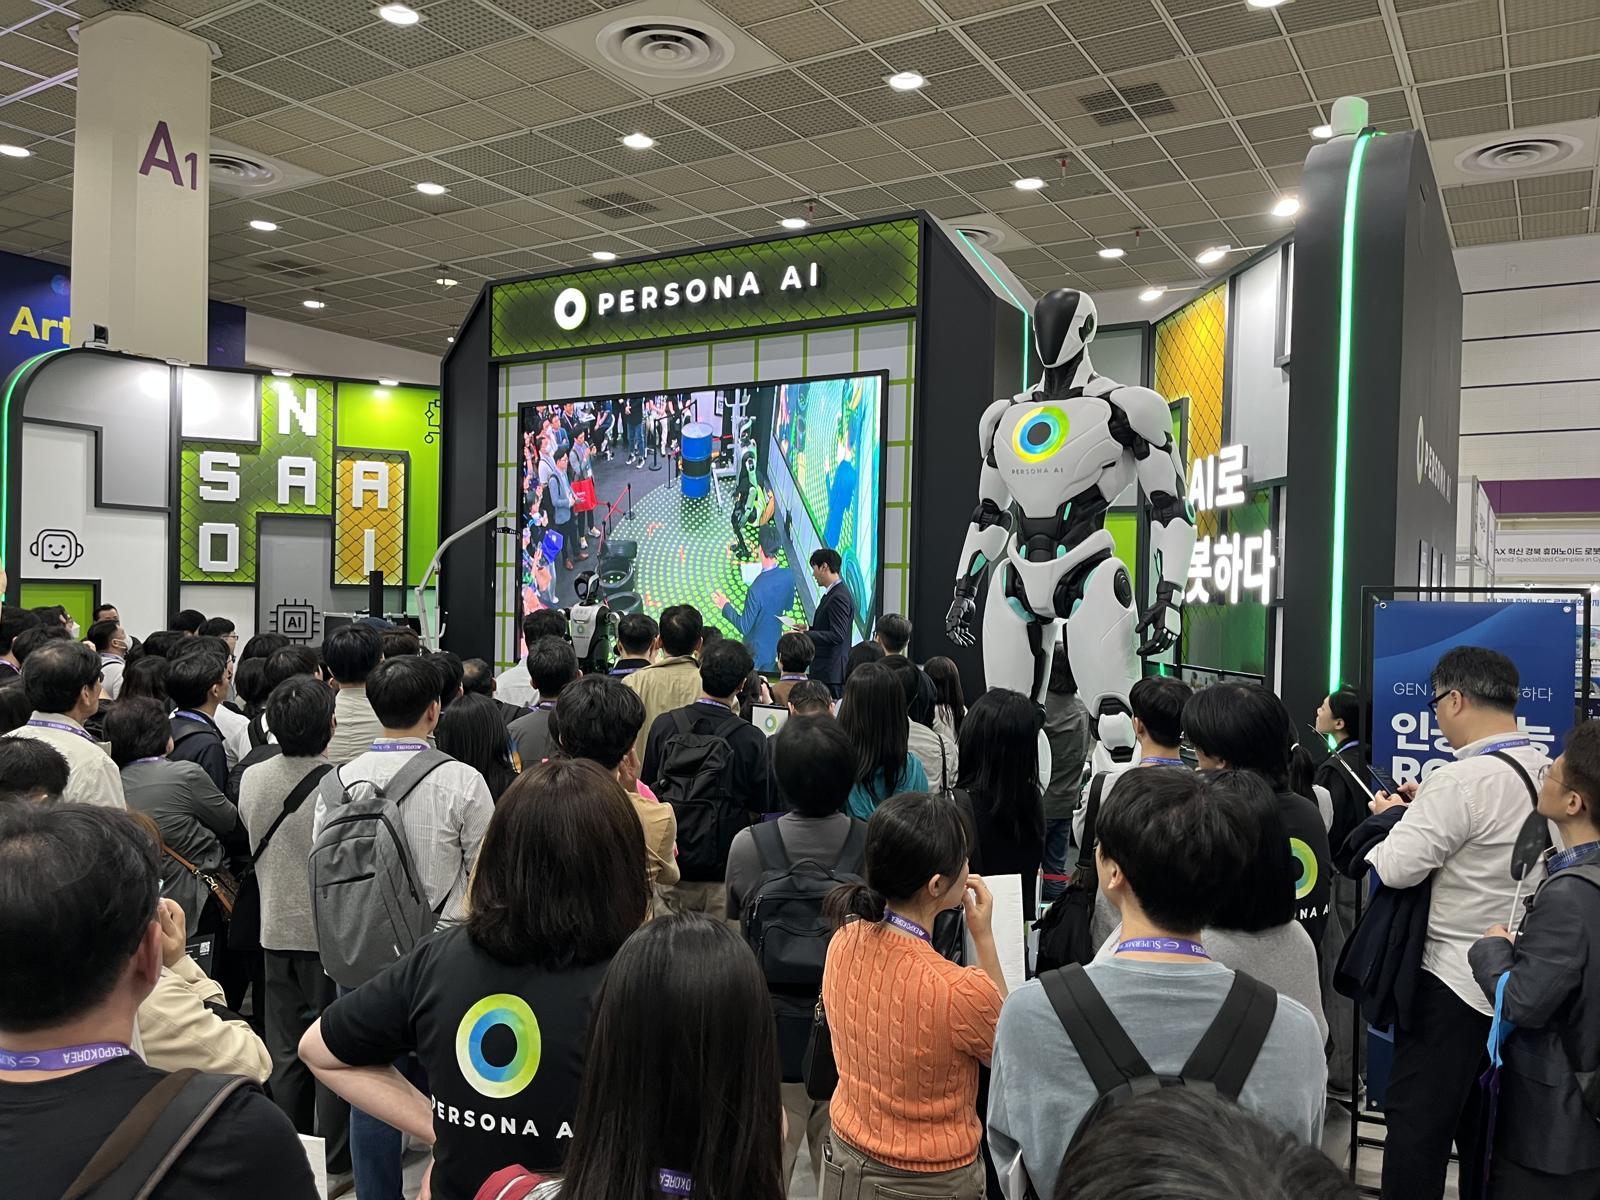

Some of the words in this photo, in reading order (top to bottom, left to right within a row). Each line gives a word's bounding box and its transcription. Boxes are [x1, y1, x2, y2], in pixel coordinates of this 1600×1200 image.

[139, 120, 198, 190] A1
[598, 271, 760, 315] PERSONA
[780, 262, 818, 291] AI
[1012, 467, 1049, 475] PERSONA
[1187, 443, 1246, 512] AI로
[1508, 548, 1523, 556] 혁신
[1526, 548, 1541, 556] 경북
[1543, 548, 1583, 556] 휴머노이드
[1182, 528, 1276, 606] 봇하다
[287, 615, 301, 628] AI
[1393, 682, 1427, 697] GEN
[1517, 686, 1553, 702] 하다
[1294, 907, 1317, 920] NA
